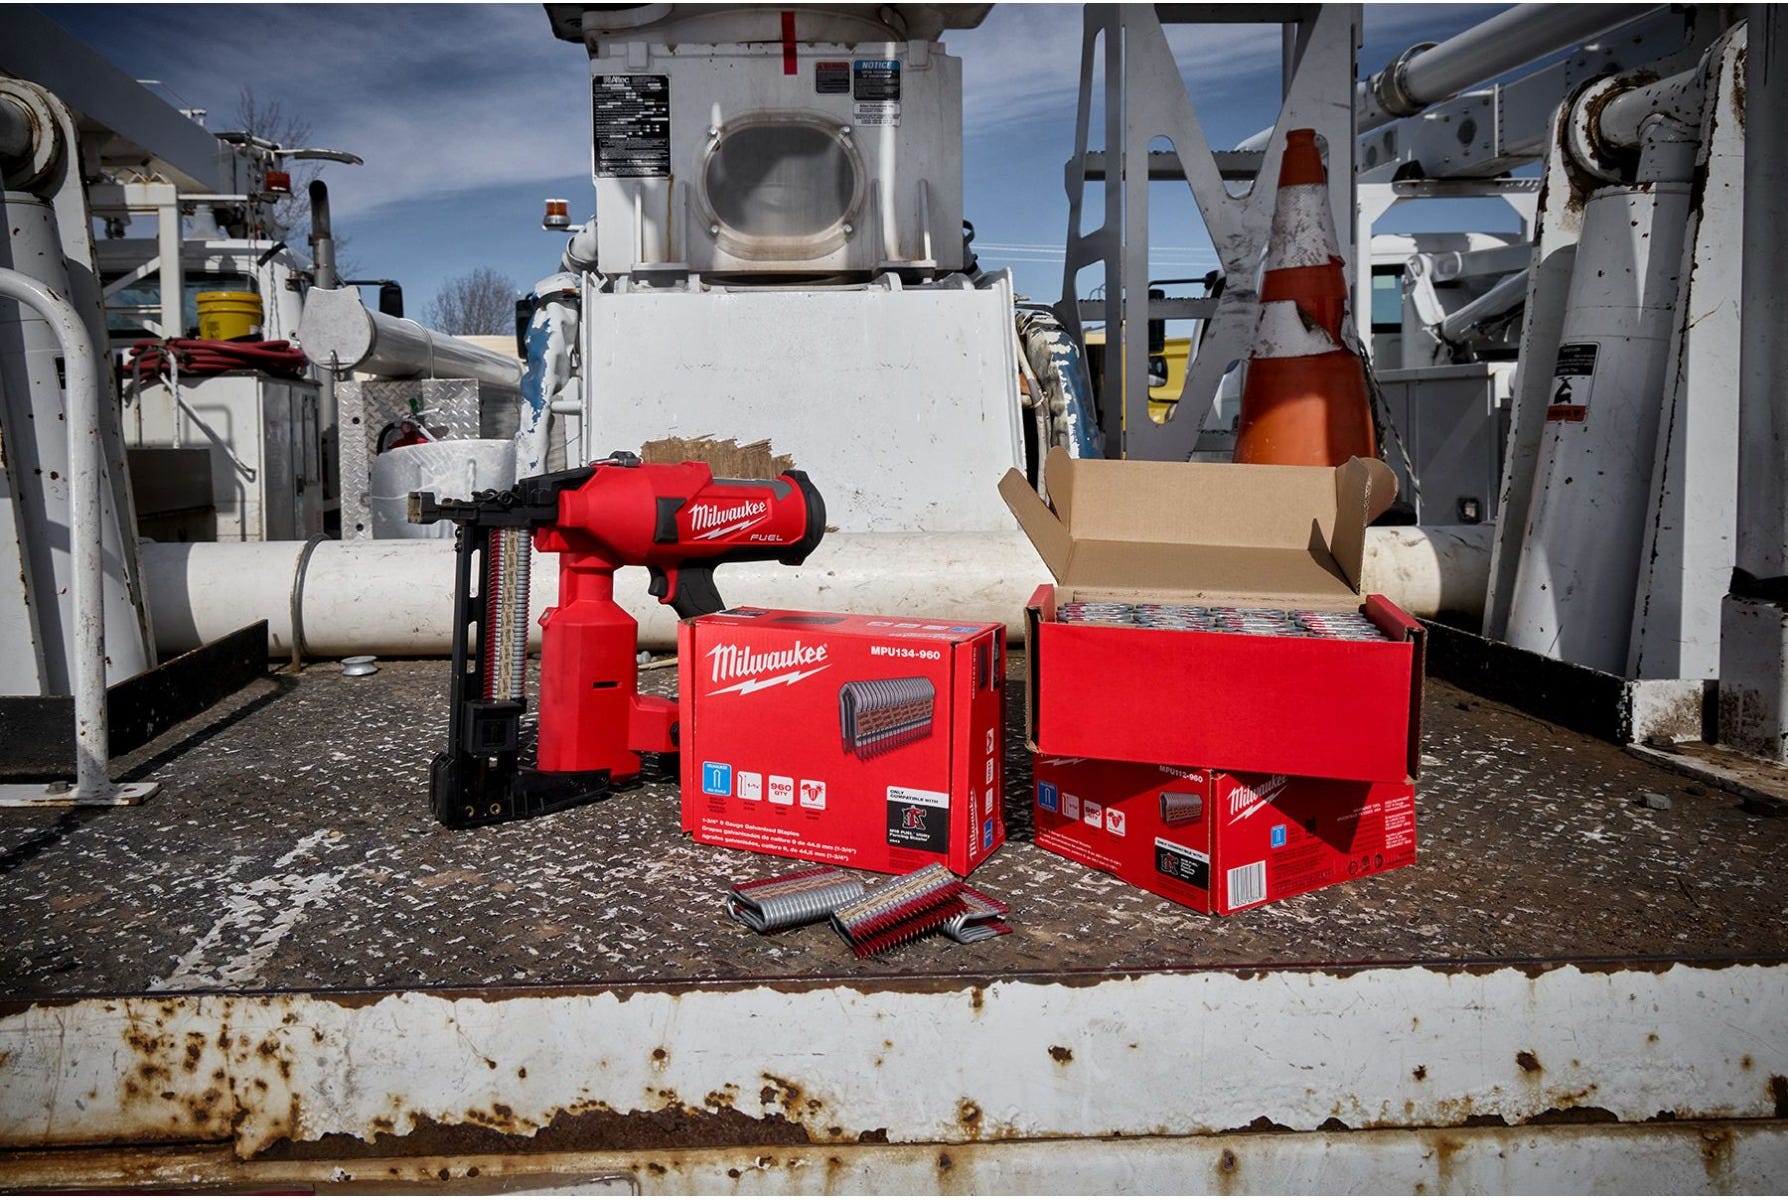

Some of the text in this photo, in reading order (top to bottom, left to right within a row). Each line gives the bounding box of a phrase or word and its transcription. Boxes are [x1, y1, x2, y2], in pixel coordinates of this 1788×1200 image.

[862, 61, 891, 69] NOTICE
[688, 500, 767, 531] Milwaukee
[871, 646, 941, 660] MPU134-960
[705, 641, 829, 683] Milwaukee
[770, 782, 792, 792] 960
[890, 794, 924, 802] COMPATIBLE
[1227, 775, 1288, 816] Milwaukee
[725, 821, 744, 829] Gauge
[777, 828, 800, 837] Staples
